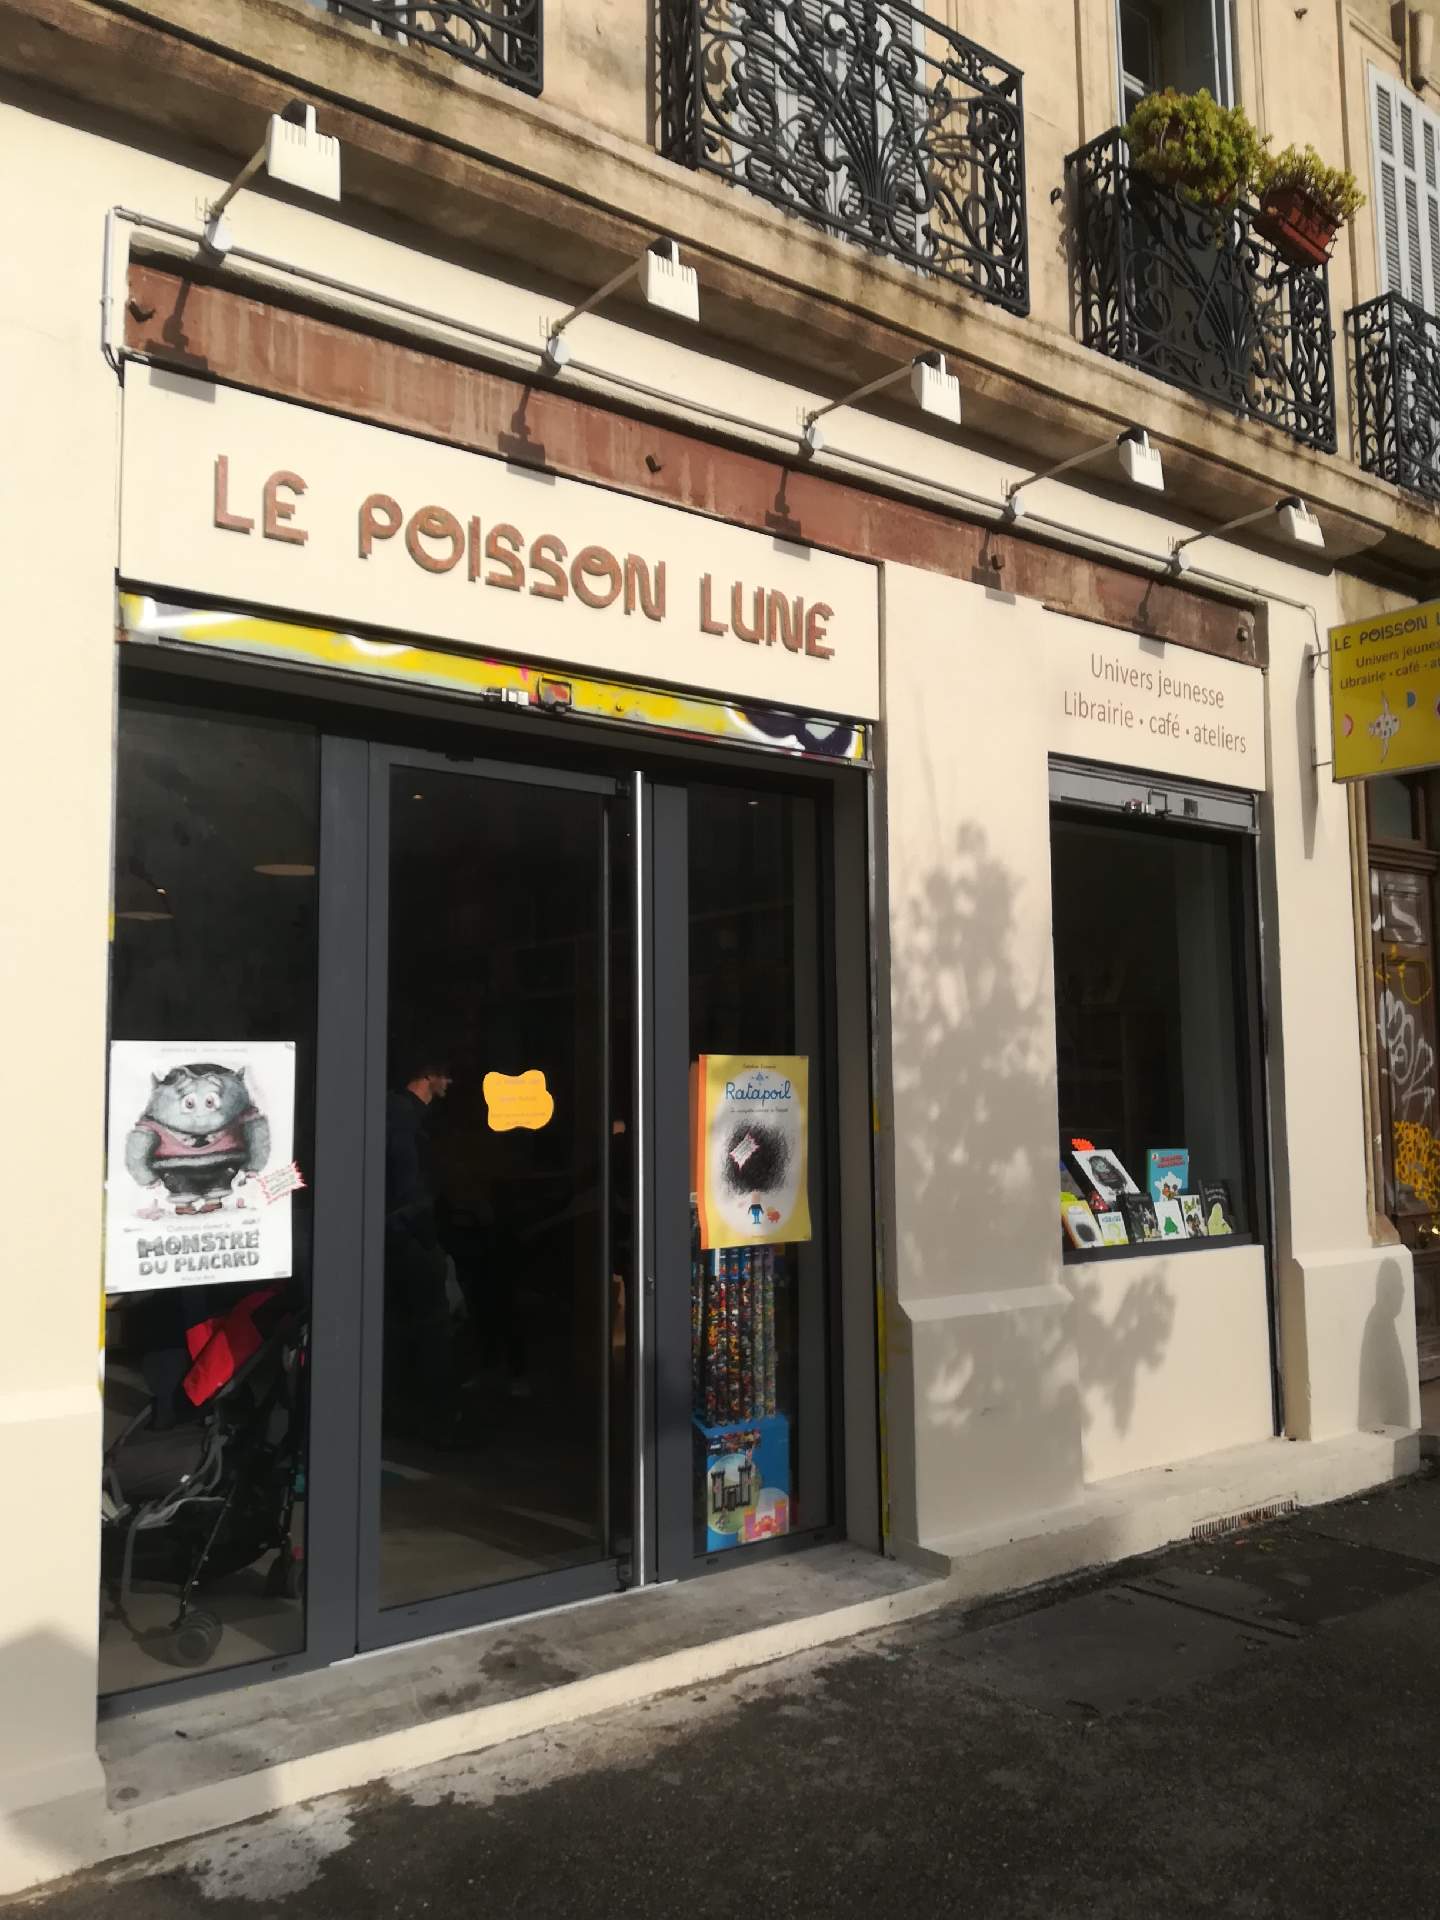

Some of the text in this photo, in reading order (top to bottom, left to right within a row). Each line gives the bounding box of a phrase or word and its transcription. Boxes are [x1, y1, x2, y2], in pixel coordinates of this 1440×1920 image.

[214, 454, 836, 660] LE POISSON LUNE
[1334, 635, 1352, 652] LE
[1359, 615, 1428, 645] POISSON
[1356, 650, 1399, 668] Univers
[1091, 653, 1225, 709] Univers jeunesse
[1340, 669, 1386, 690] Librairie
[1395, 661, 1420, 677] café
[1064, 690, 1247, 753] Librairie café ateliers
[726, 1080, 792, 1107] Ratapoil
[137, 1229, 260, 1259] MONSTRE
[138, 1251, 260, 1276] DU PLACARD
